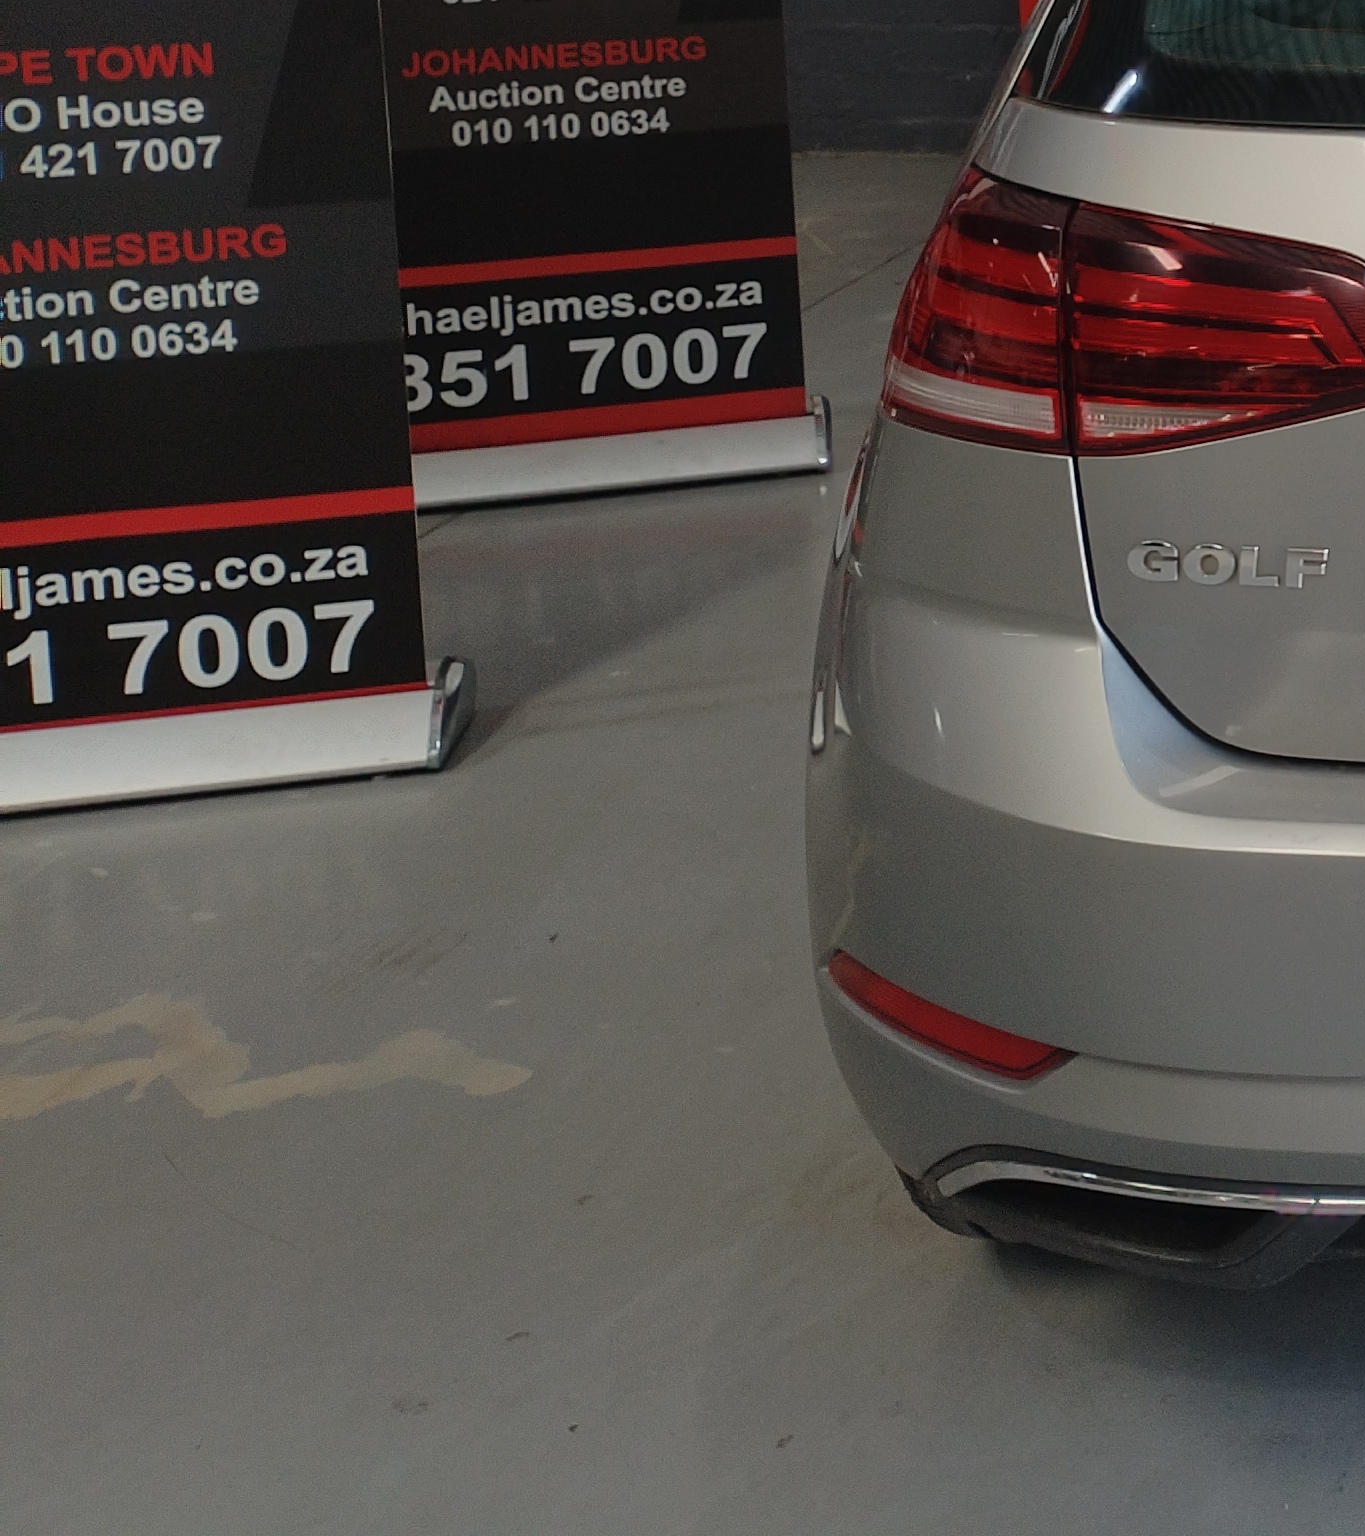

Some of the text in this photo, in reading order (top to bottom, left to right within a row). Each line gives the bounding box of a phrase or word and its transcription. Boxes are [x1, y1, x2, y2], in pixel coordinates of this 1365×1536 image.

[65, 41, 215, 82] TOWN
[402, 35, 707, 79] JOHANNESBURG
[57, 95, 205, 130] House
[429, 74, 687, 113] Auction Centre
[452, 107, 670, 148] 010 110 0634
[20, 135, 222, 179] 421 7007
[0, 223, 287, 275] NNESBURG
[0, 275, 259, 322] tion Centre
[404, 280, 763, 337] haeljames.co.za
[41, 327, 117, 364] 110
[131, 318, 239, 358] 0634
[568, 322, 768, 395] 7007
[0, 543, 369, 620] ljames.co.za
[1126, 539, 1331, 590] GOLF
[107, 599, 375, 695] 7007
